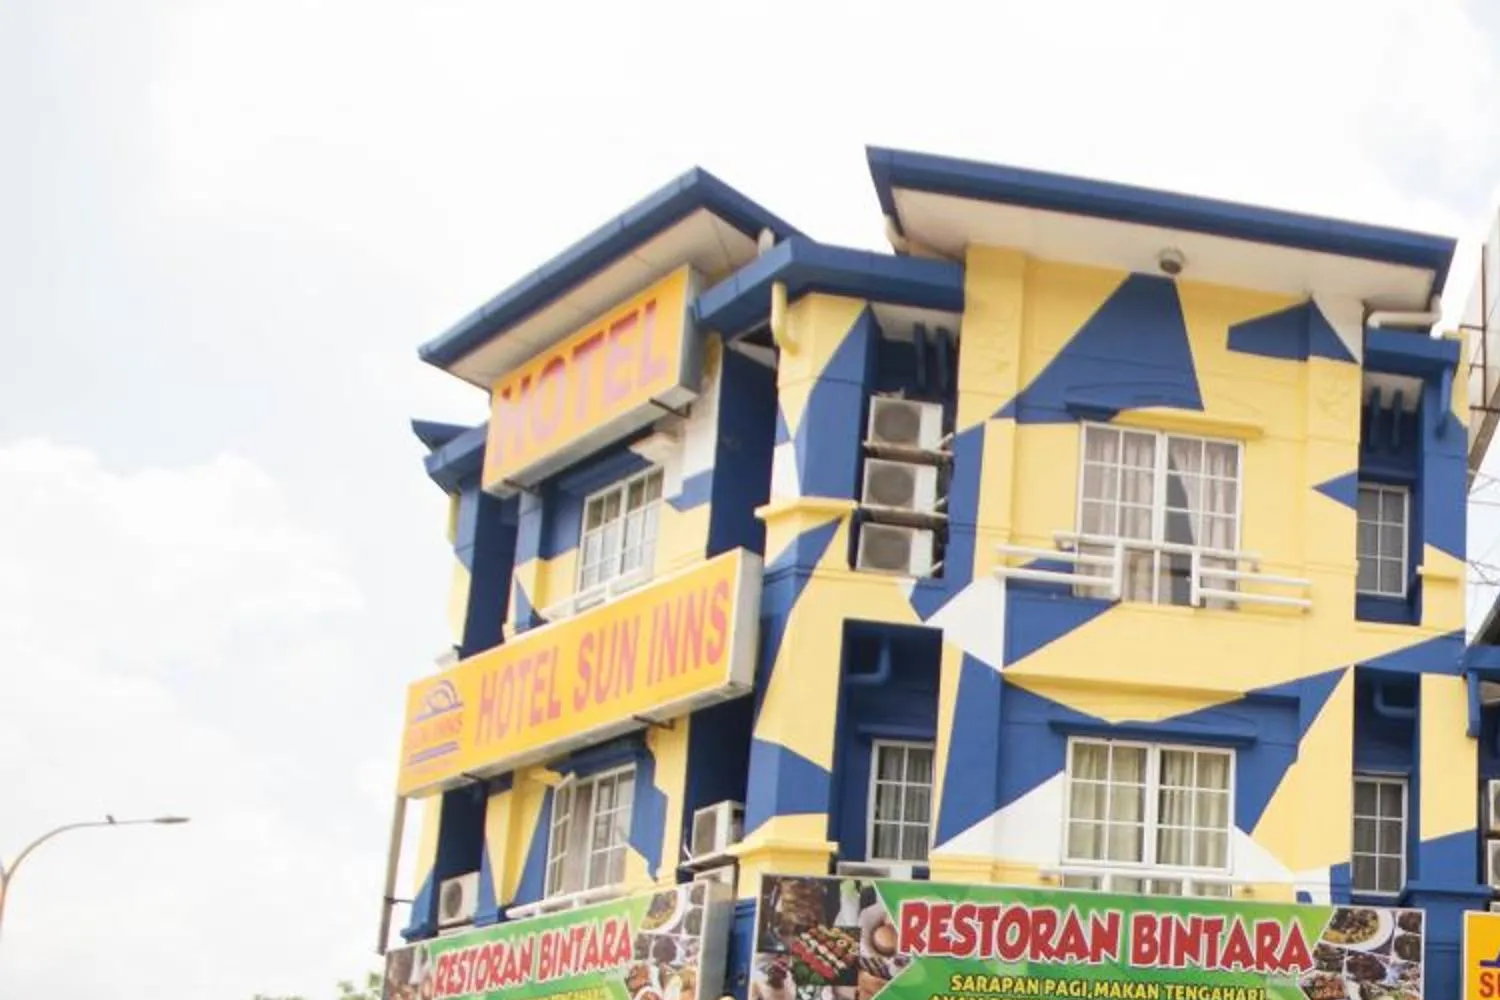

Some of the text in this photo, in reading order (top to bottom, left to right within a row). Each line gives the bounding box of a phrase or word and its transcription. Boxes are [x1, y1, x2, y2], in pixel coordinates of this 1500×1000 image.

[493, 297, 669, 466] HOTEL
[474, 577, 729, 747] HOTEL SUN INNS
[433, 918, 633, 996] RESTORAN BINTARA
[899, 901, 1314, 973] RESTORAN BINTARA
[951, 974, 1039, 995] SARAPAN
